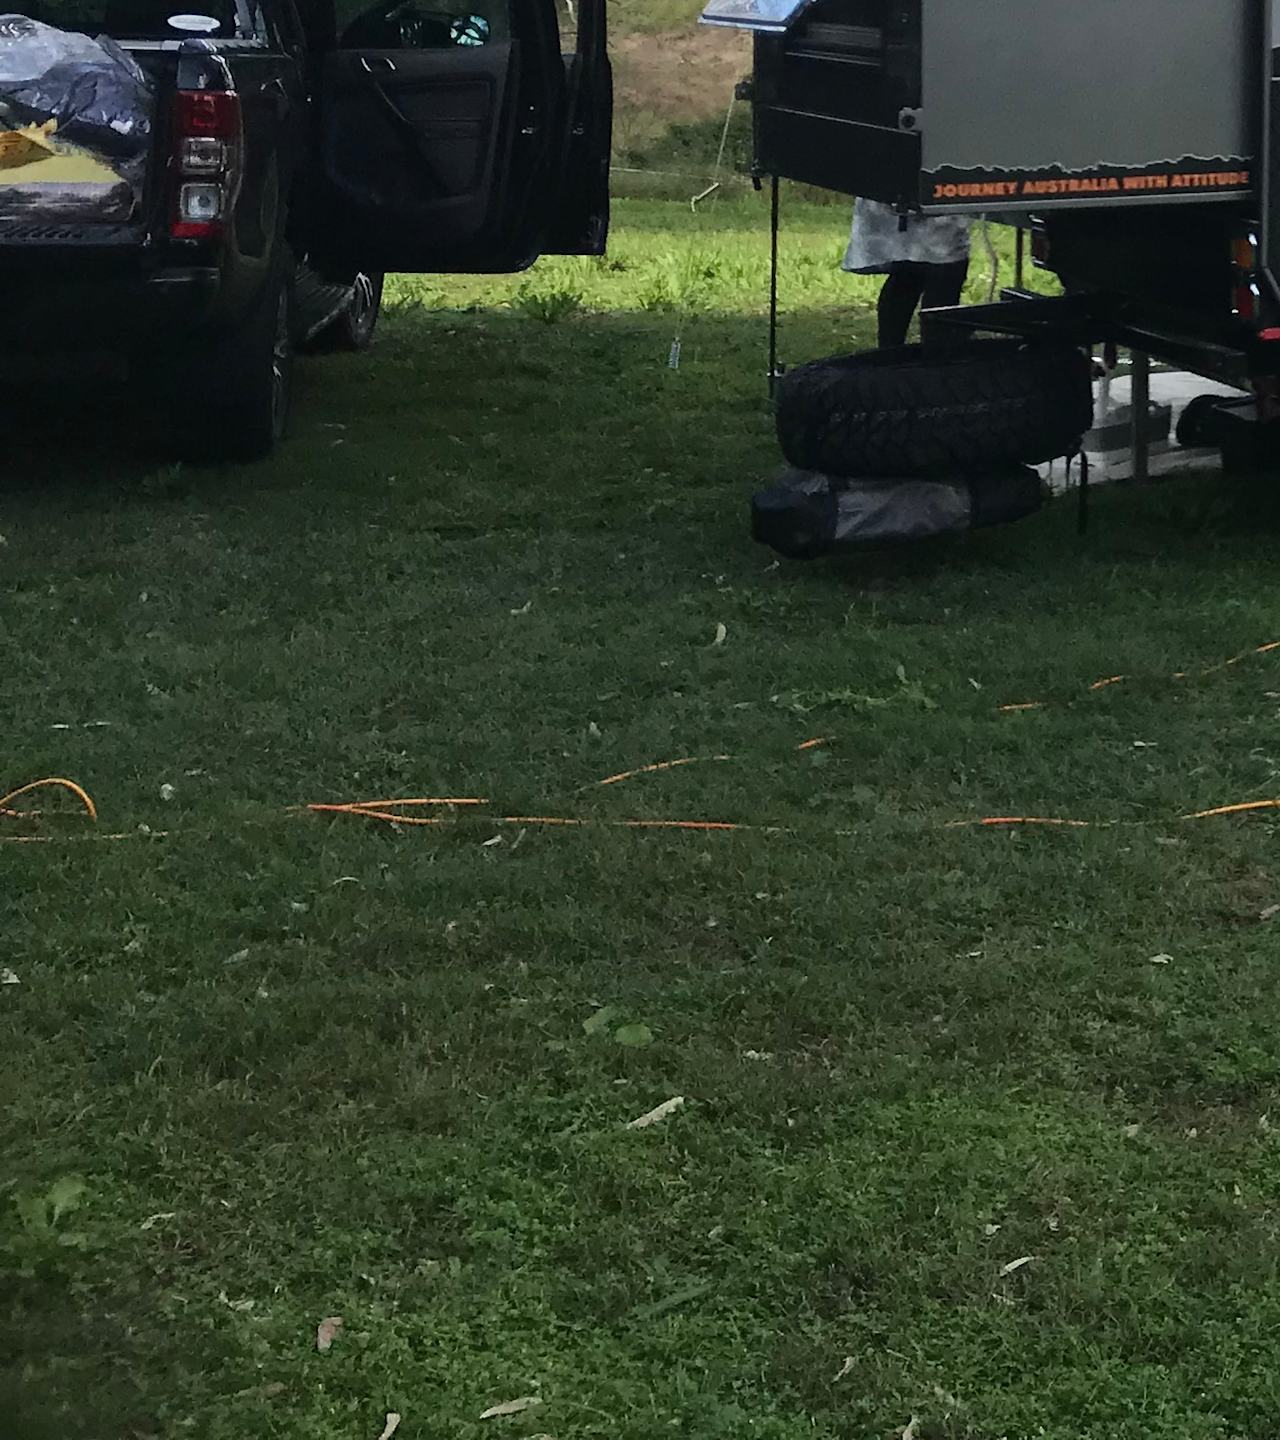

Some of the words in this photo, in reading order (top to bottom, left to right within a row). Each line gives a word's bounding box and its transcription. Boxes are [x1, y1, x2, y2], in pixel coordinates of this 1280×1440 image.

[932, 181, 1018, 198] JOURNEY
[1022, 178, 1119, 195] AUSTRALIA
[1122, 175, 1168, 190] WITH
[1171, 171, 1249, 188] ATTITUDE
